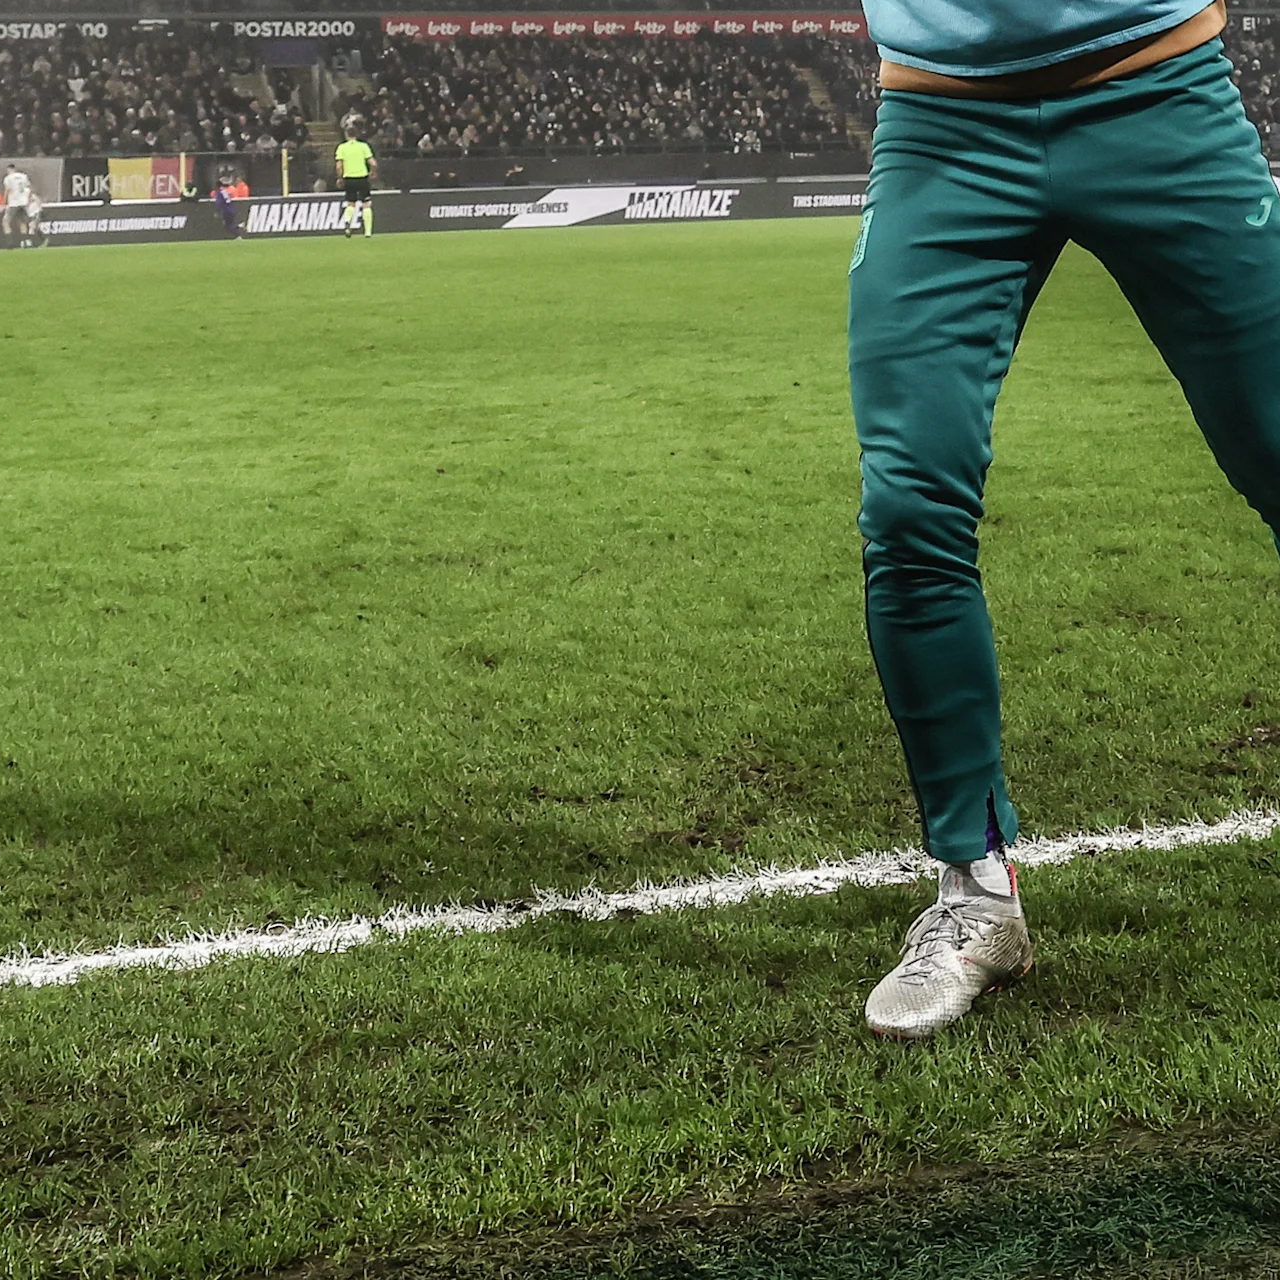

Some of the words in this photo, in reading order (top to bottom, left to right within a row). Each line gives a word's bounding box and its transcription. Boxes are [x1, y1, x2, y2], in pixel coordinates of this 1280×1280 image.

[624, 189, 736, 219] MAXAMAZE
[794, 196, 812, 207] THIS
[813, 195, 851, 206] STADIUM
[852, 194, 861, 205] IS
[429, 205, 474, 218] ULTIMATE
[474, 203, 510, 216] SPORTS
